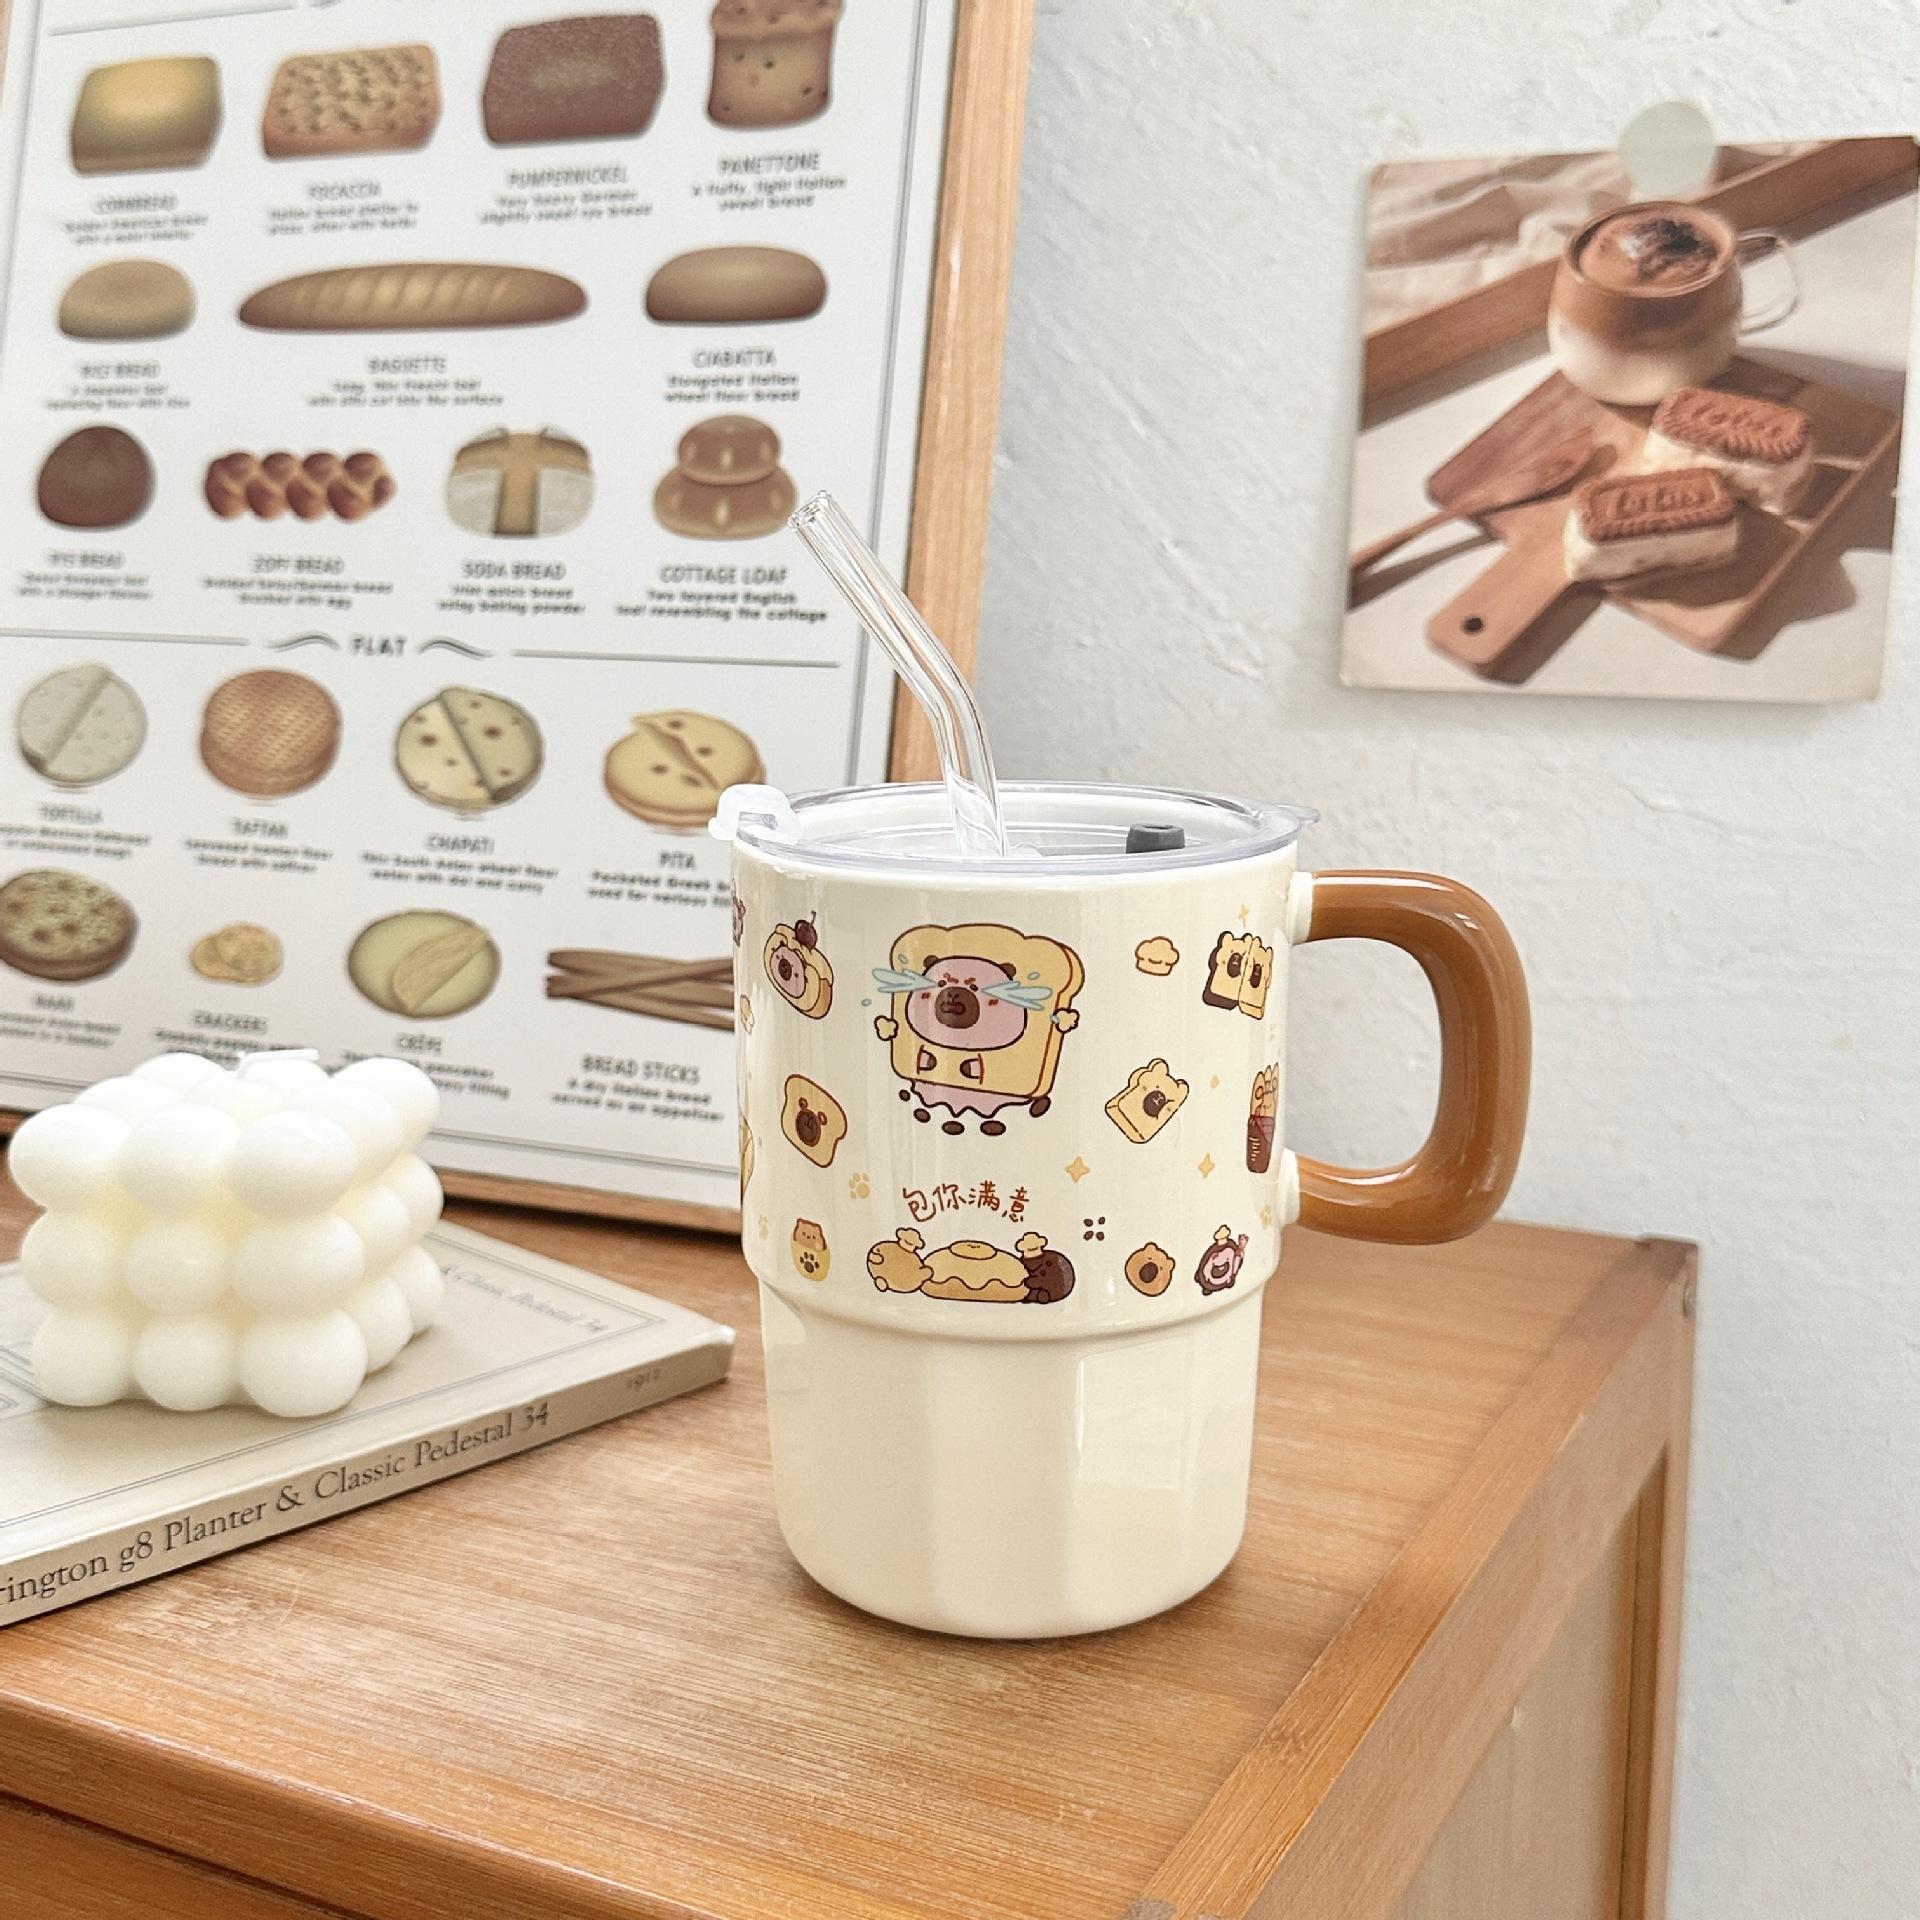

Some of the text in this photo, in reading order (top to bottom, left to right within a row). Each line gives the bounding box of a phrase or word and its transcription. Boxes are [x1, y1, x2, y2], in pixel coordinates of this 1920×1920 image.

[720, 152, 821, 174] PANETTONE
[507, 165, 627, 187] PUMPERNICKEL
[367, 355, 447, 374] BAGUETTE
[692, 349, 776, 368] CIABATTA
[462, 560, 567, 581] SODA BREAD
[660, 565, 788, 586] COTTAGE LOAF
[351, 633, 407, 656] FLAT
[426, 833, 495, 854] CHAPATI
[660, 851, 697, 871] PITA
[581, 1054, 701, 1086] BREAD STICKS
[902, 1179, 1031, 1223] 包你满意
[0, 1554, 109, 1604] ington
[118, 1531, 154, 1573] g8
[163, 1500, 268, 1552] Planter
[273, 1484, 304, 1512] &
[313, 1453, 406, 1499] Classic
[414, 1412, 512, 1468] Pedestal
[520, 1402, 549, 1433] 34
